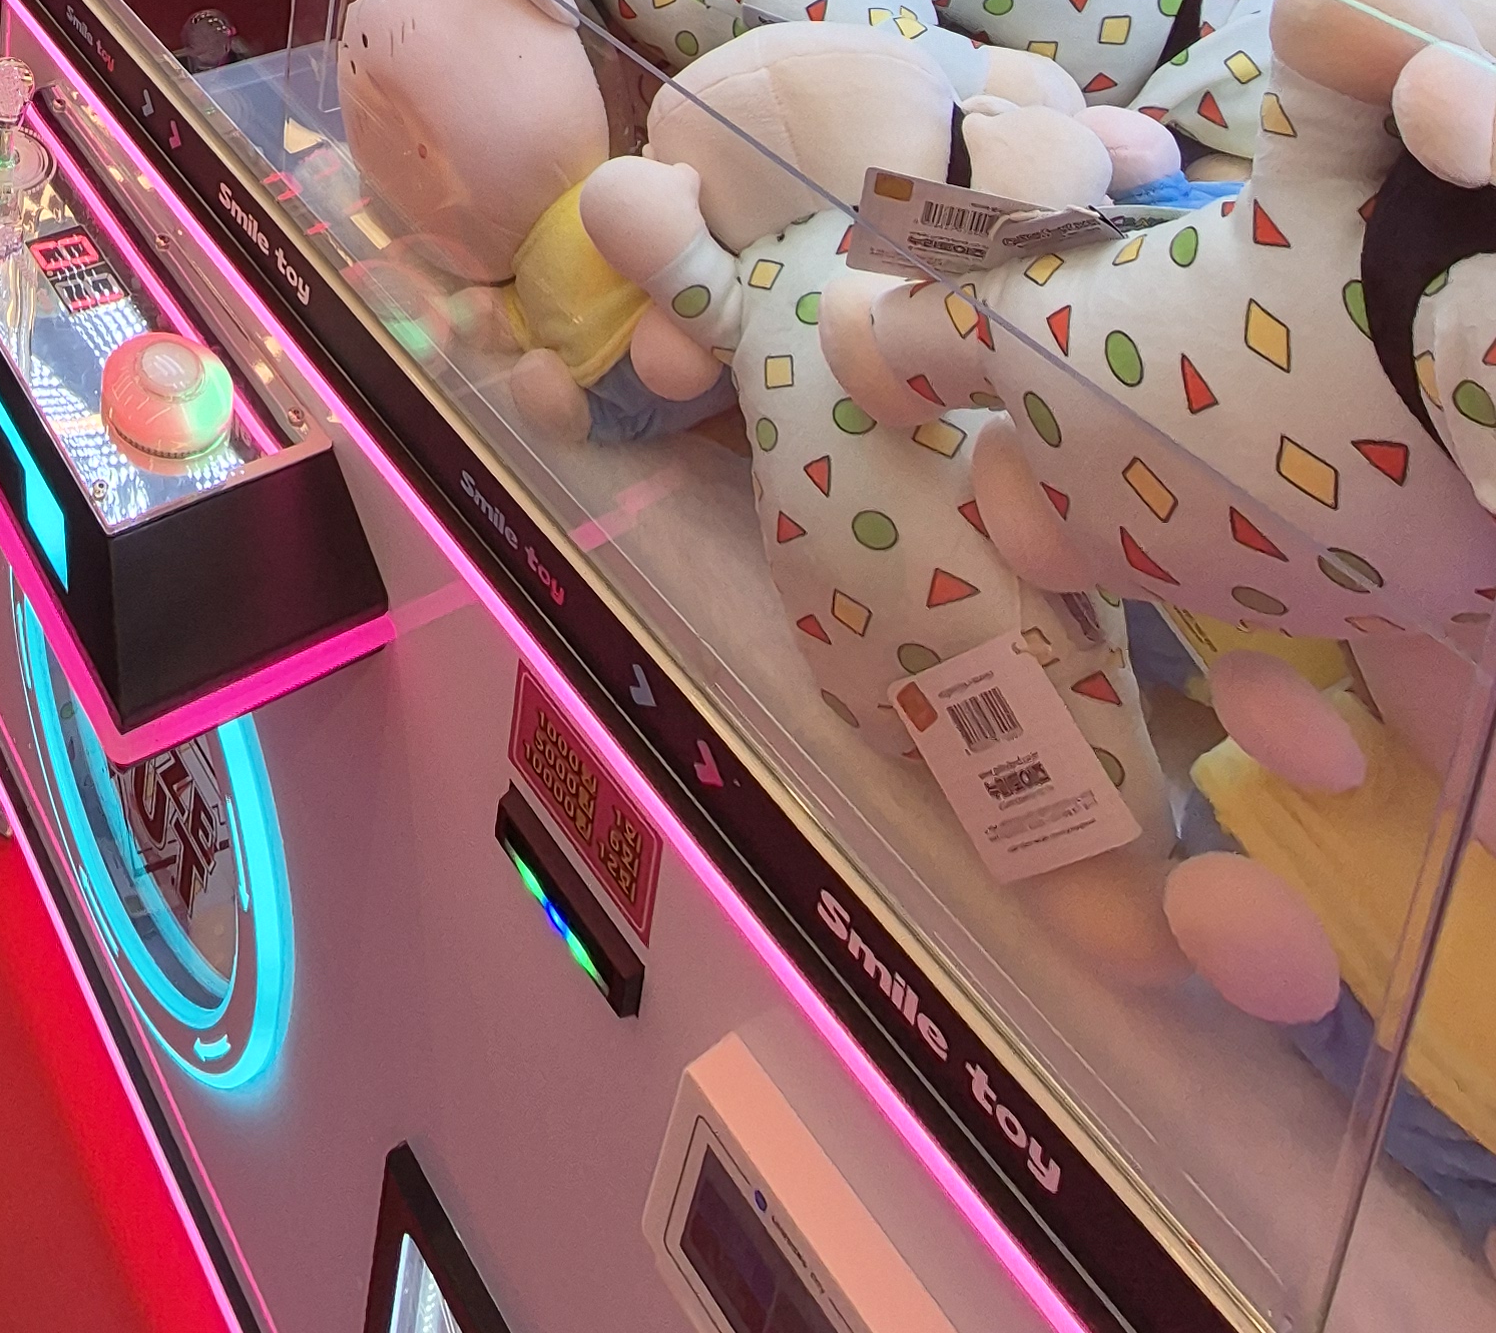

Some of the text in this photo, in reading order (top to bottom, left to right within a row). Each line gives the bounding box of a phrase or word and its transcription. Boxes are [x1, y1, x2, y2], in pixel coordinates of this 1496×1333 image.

[64, 4, 116, 73] Smile toy
[217, 182, 312, 307] Smile toy
[459, 469, 566, 607] Smile toy
[816, 887, 1063, 1196] Smile toy
